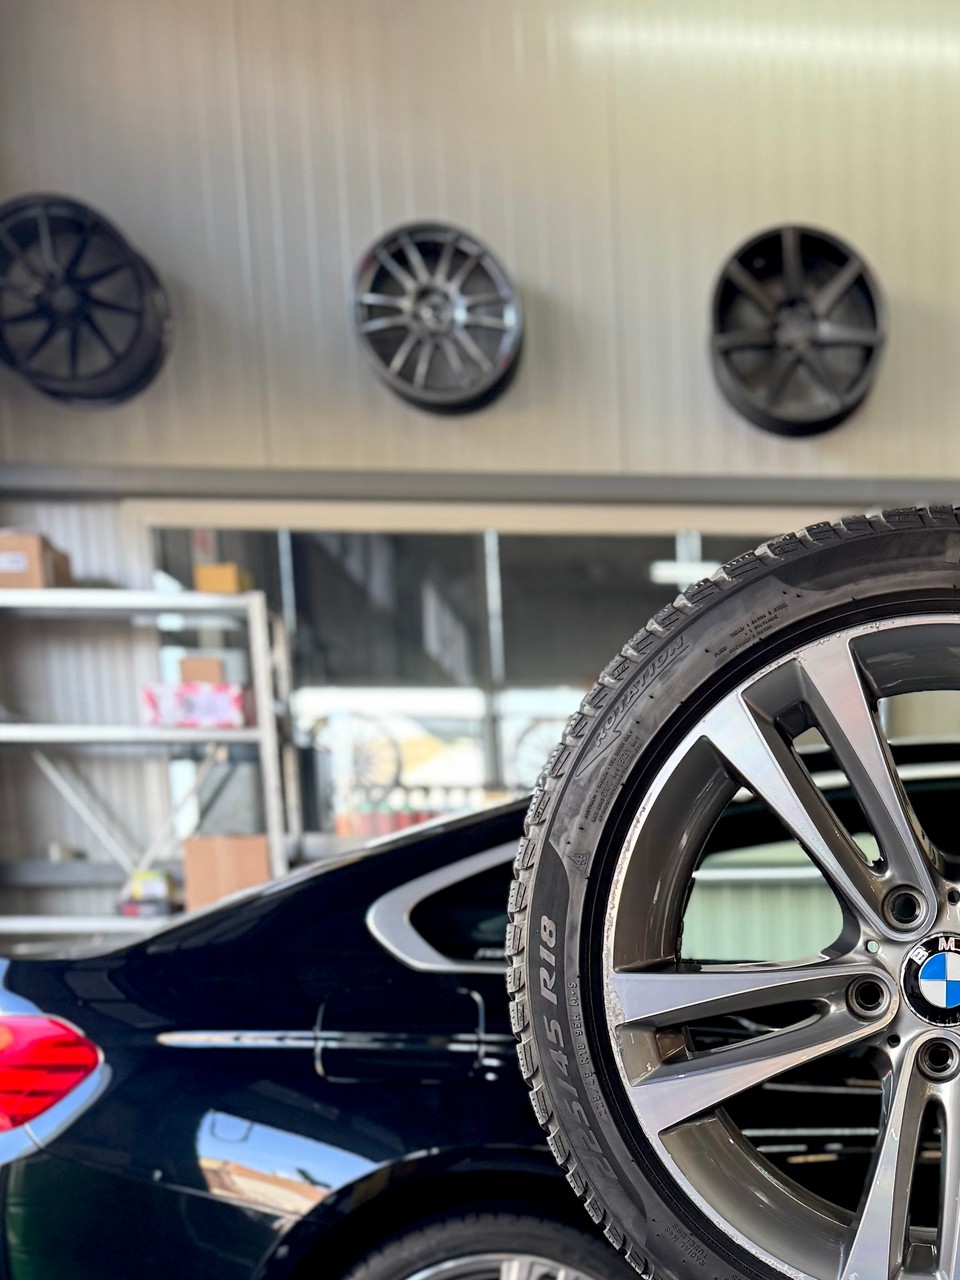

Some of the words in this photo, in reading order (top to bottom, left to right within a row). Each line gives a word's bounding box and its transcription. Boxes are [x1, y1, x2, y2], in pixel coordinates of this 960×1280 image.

[597, 636, 685, 741] ROTATION
[541, 915, 558, 1006] R18
[545, 1016, 619, 1185] 225/45
[669, 1222, 709, 1259] TUBELESS
[677, 1241, 706, 1267] RADIAL
